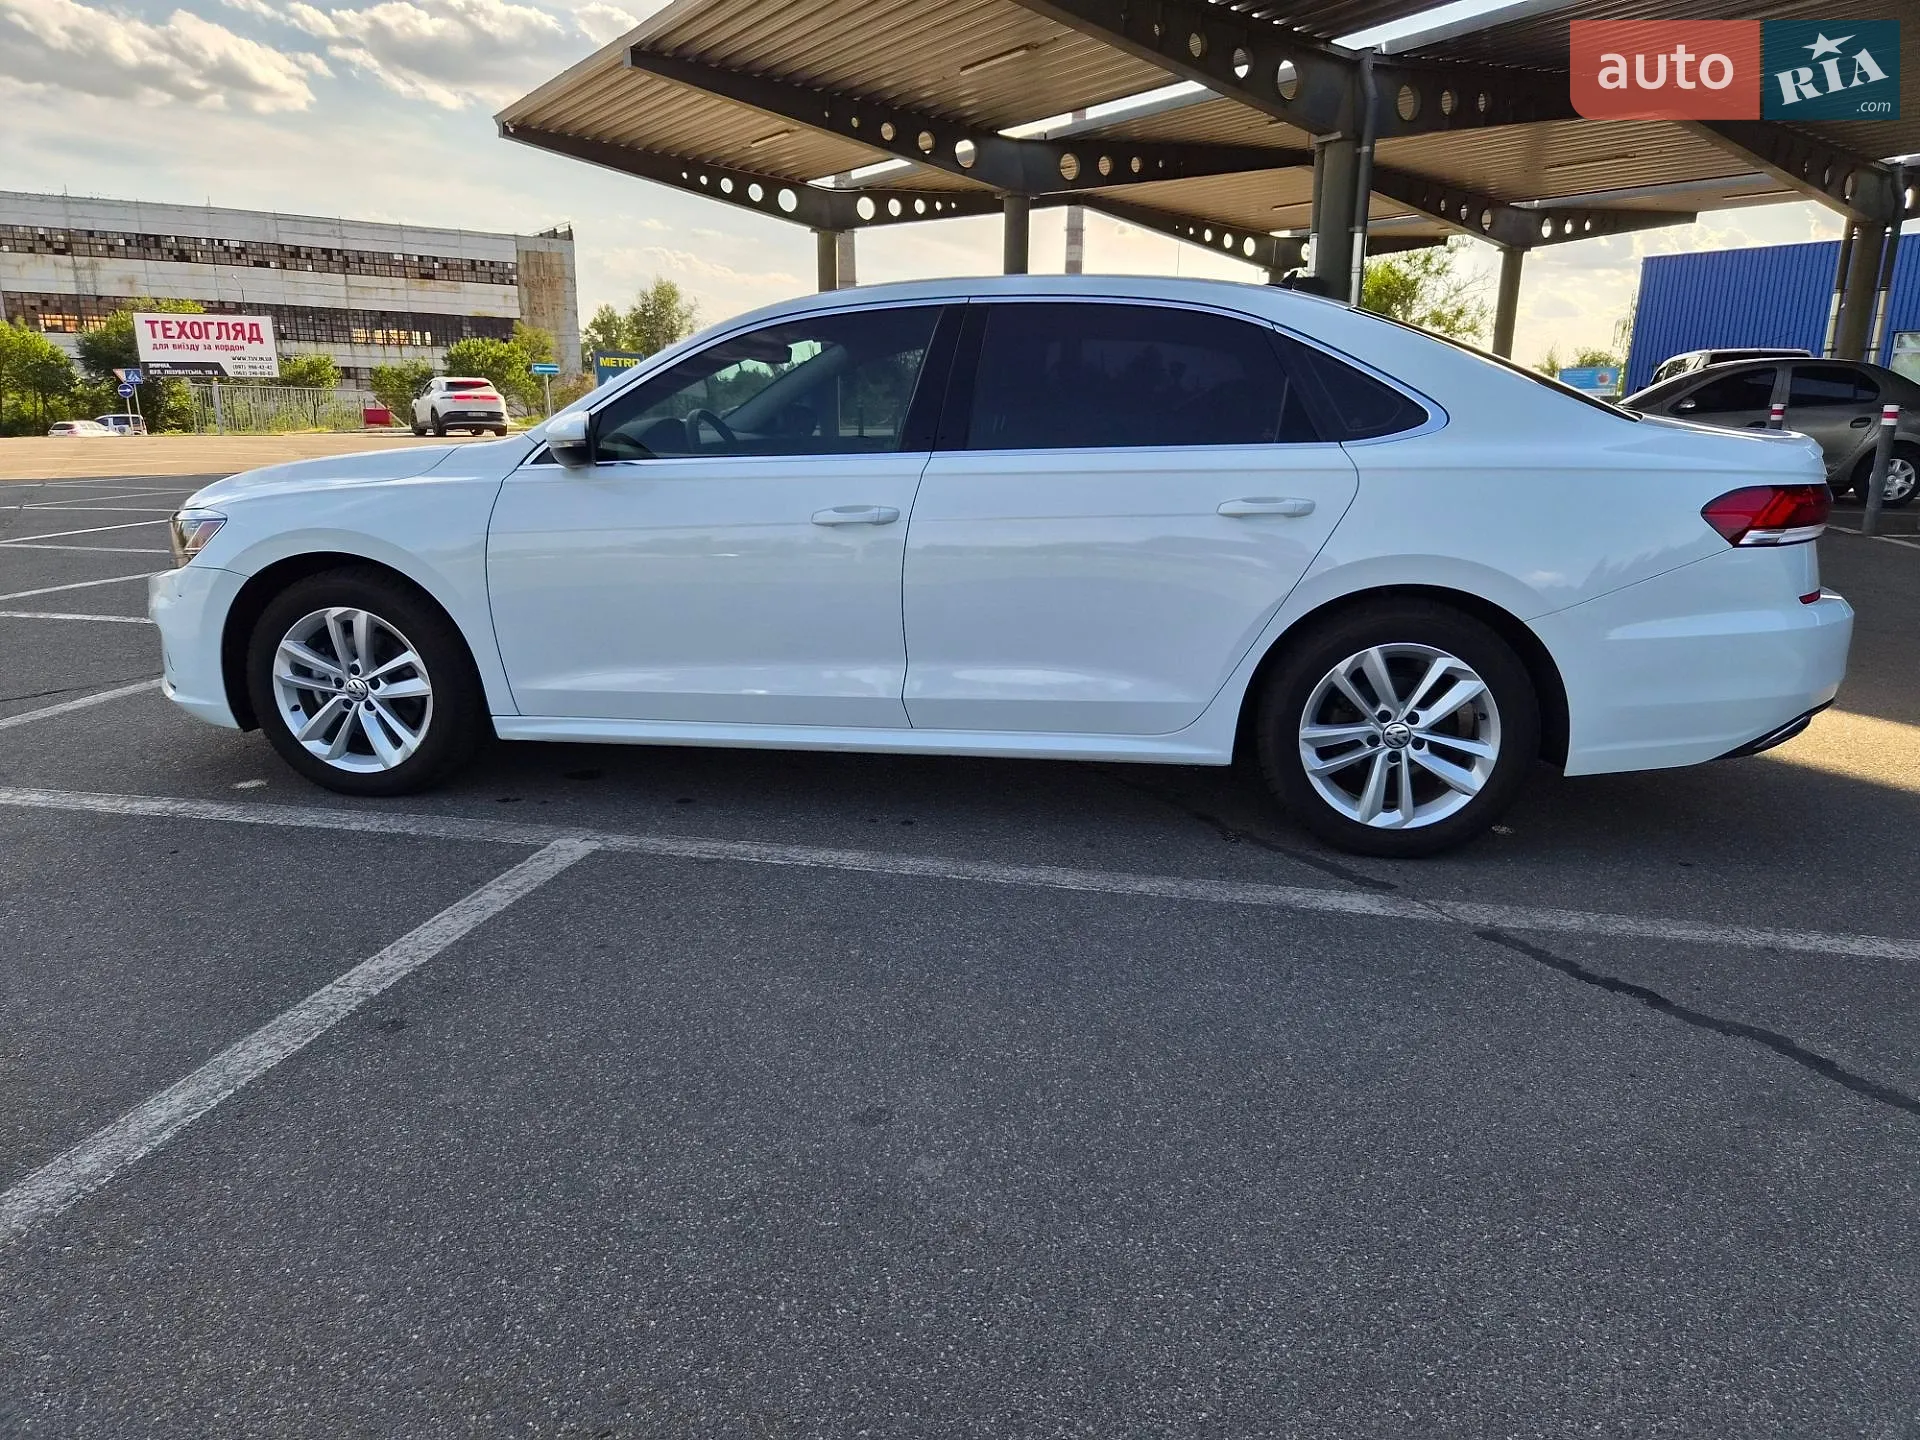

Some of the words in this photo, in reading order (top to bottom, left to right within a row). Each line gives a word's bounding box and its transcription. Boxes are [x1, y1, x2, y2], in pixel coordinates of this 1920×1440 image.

[145, 320, 264, 345] ТЕХОГЛЯД
[152, 343, 169, 351] для
[173, 342, 199, 352] виїзду
[203, 344, 212, 352] за
[215, 345, 245, 353] кордон
[599, 356, 641, 368] METRO
